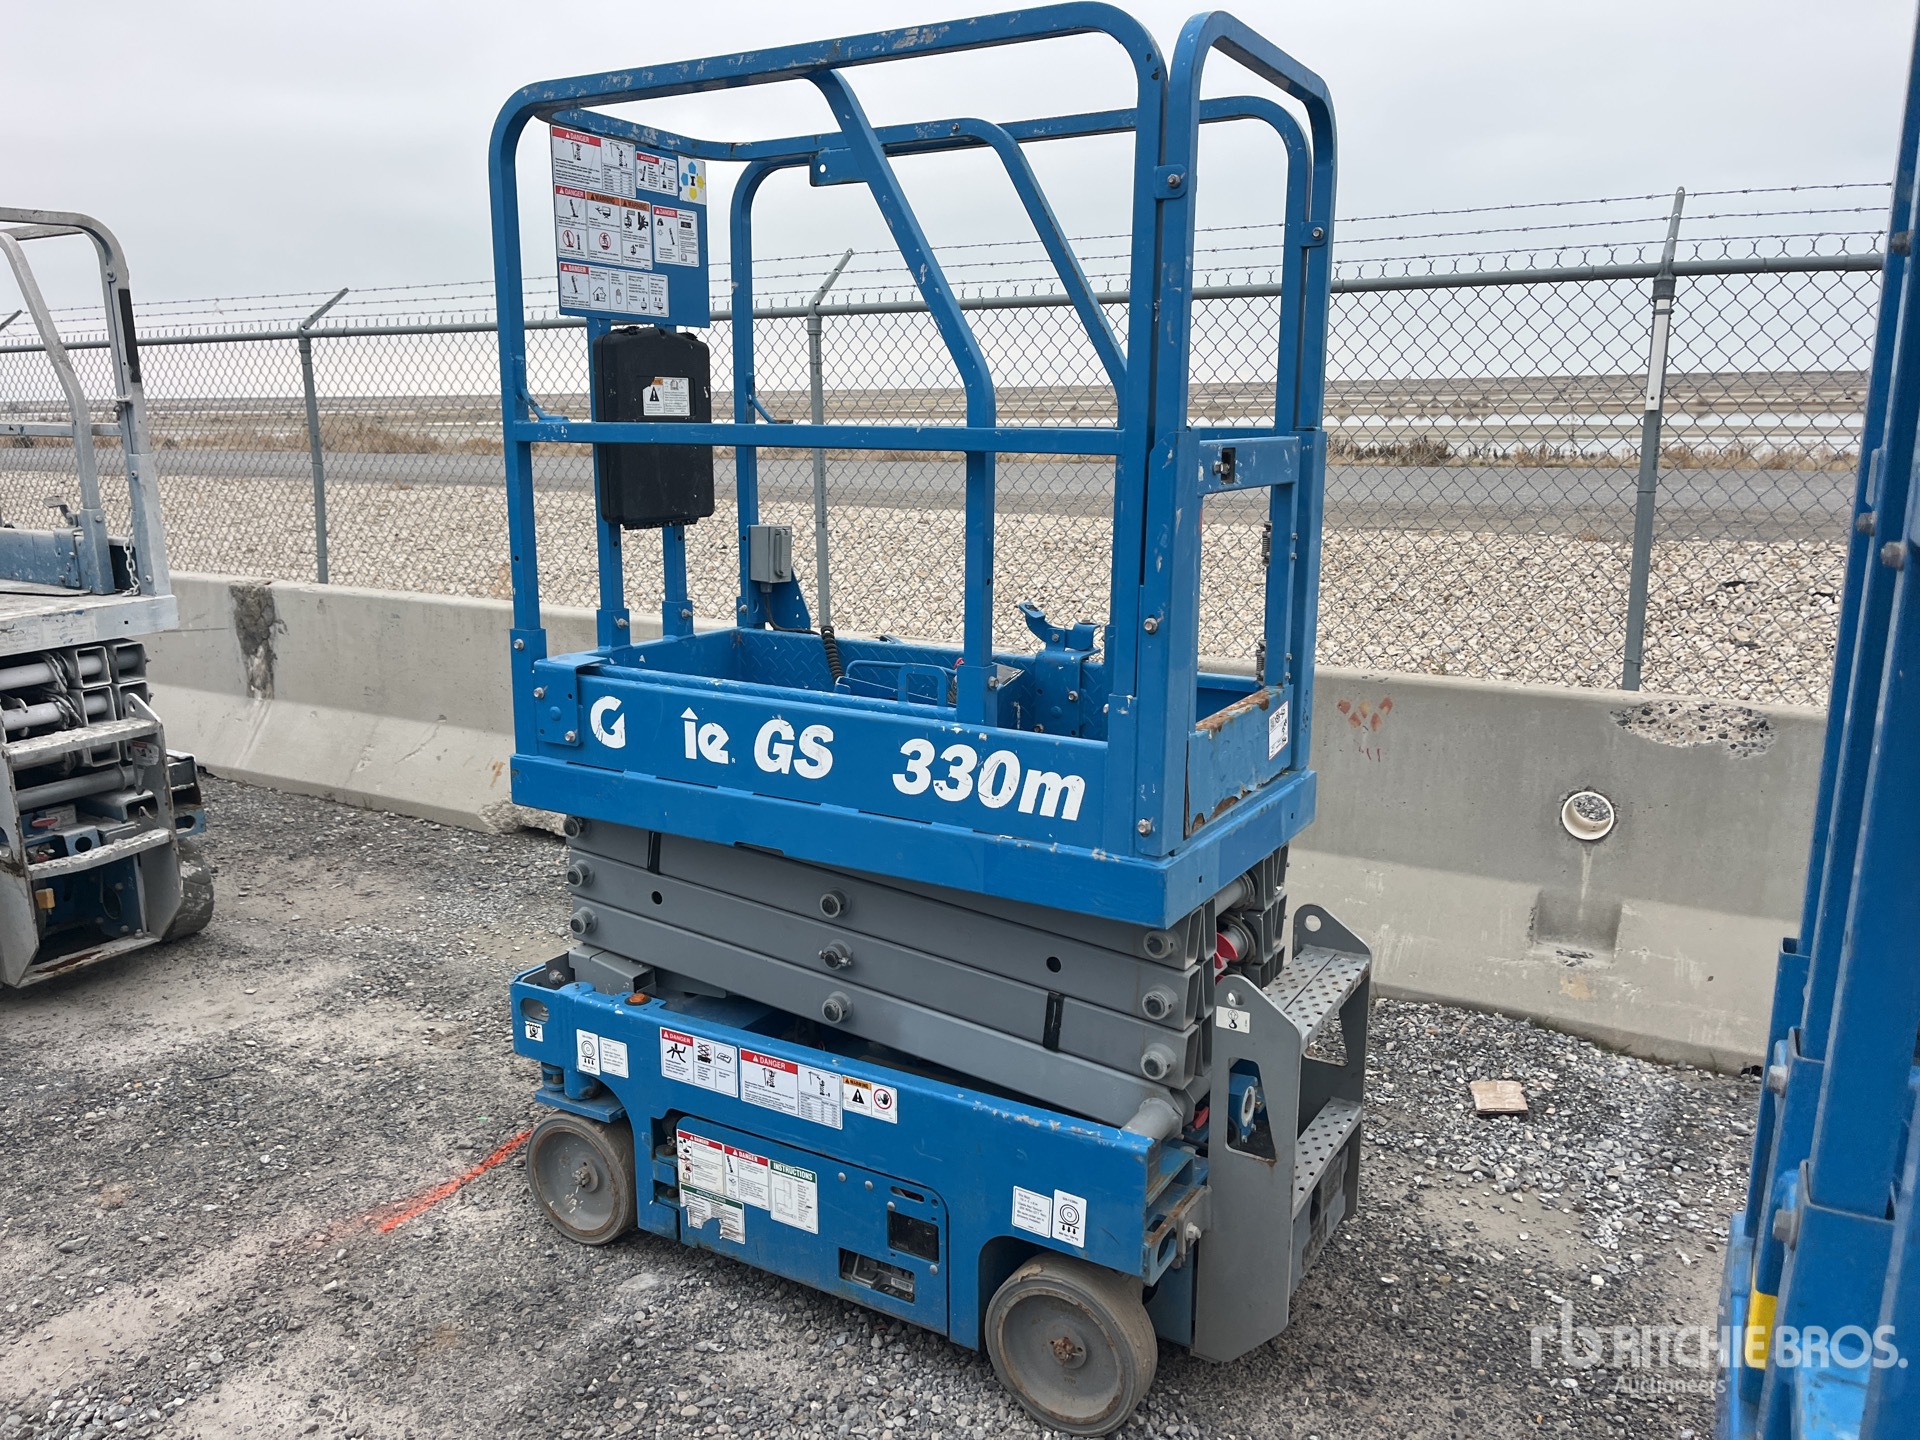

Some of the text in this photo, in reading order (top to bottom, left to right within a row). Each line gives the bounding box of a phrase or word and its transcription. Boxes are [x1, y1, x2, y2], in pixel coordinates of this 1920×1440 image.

[570, 133, 589, 143] DANGER
[565, 189, 584, 198] DANGER
[660, 208, 676, 216] DANGER
[568, 264, 587, 273] DANGER
[753, 717, 834, 780] GS
[892, 738, 1085, 822] 330m
[669, 1033, 691, 1044] DANGER
[759, 1056, 786, 1070] DANGER
[694, 1136, 710, 1146] DANGER
[738, 1151, 758, 1163] DANGER
[773, 1162, 813, 1181] INSTRUCTIONS
